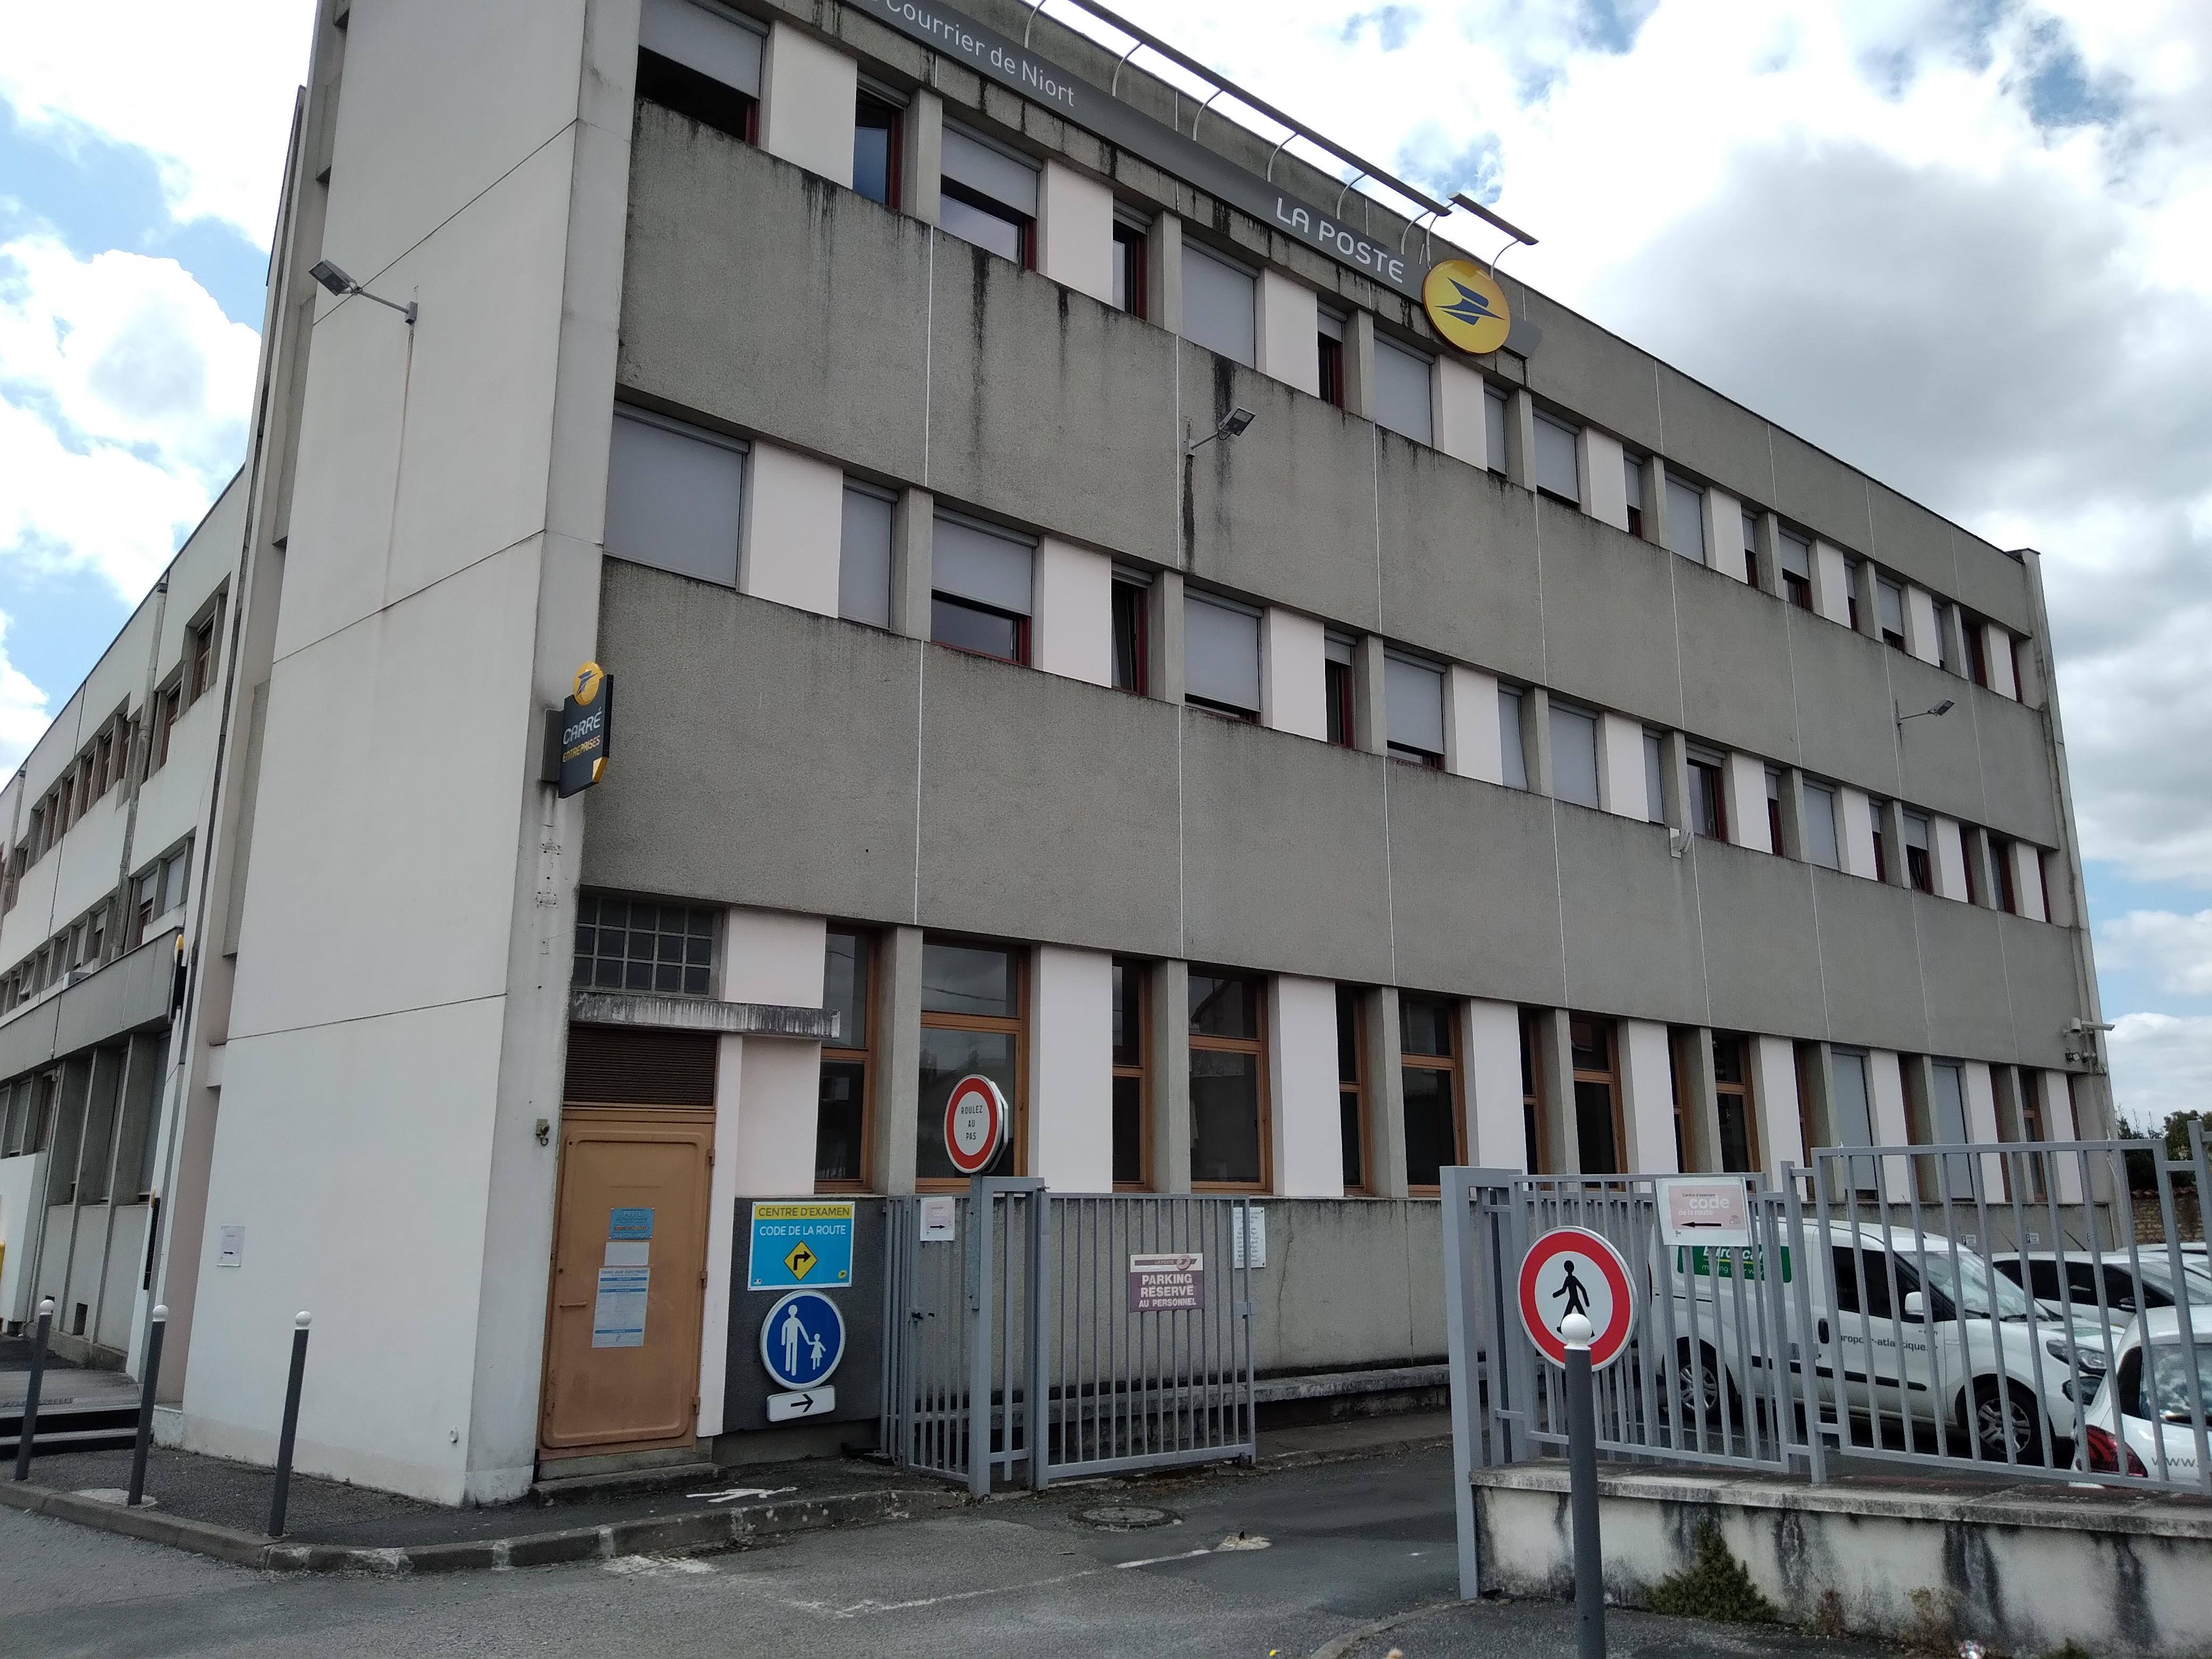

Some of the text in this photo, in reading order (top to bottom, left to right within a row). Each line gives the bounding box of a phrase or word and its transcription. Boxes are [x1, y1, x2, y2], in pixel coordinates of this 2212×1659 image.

[886, 0, 1074, 107] Courrier de Niort
[1276, 197, 1404, 283] LA POSTE
[563, 706, 602, 745] CARRÉ
[562, 735, 600, 763] ENTREPRISES
[961, 1105, 983, 1115] ROULEZ
[966, 1132, 976, 1141] PAS
[1689, 1194, 1731, 1209] code
[758, 1207, 850, 1217] CENTRE D'EXAMEN
[759, 1225, 847, 1236] CODE DE LA ROUTE
[1142, 1273, 1193, 1285] PARKING
[1152, 1298, 1197, 1307] PERSONNEL
